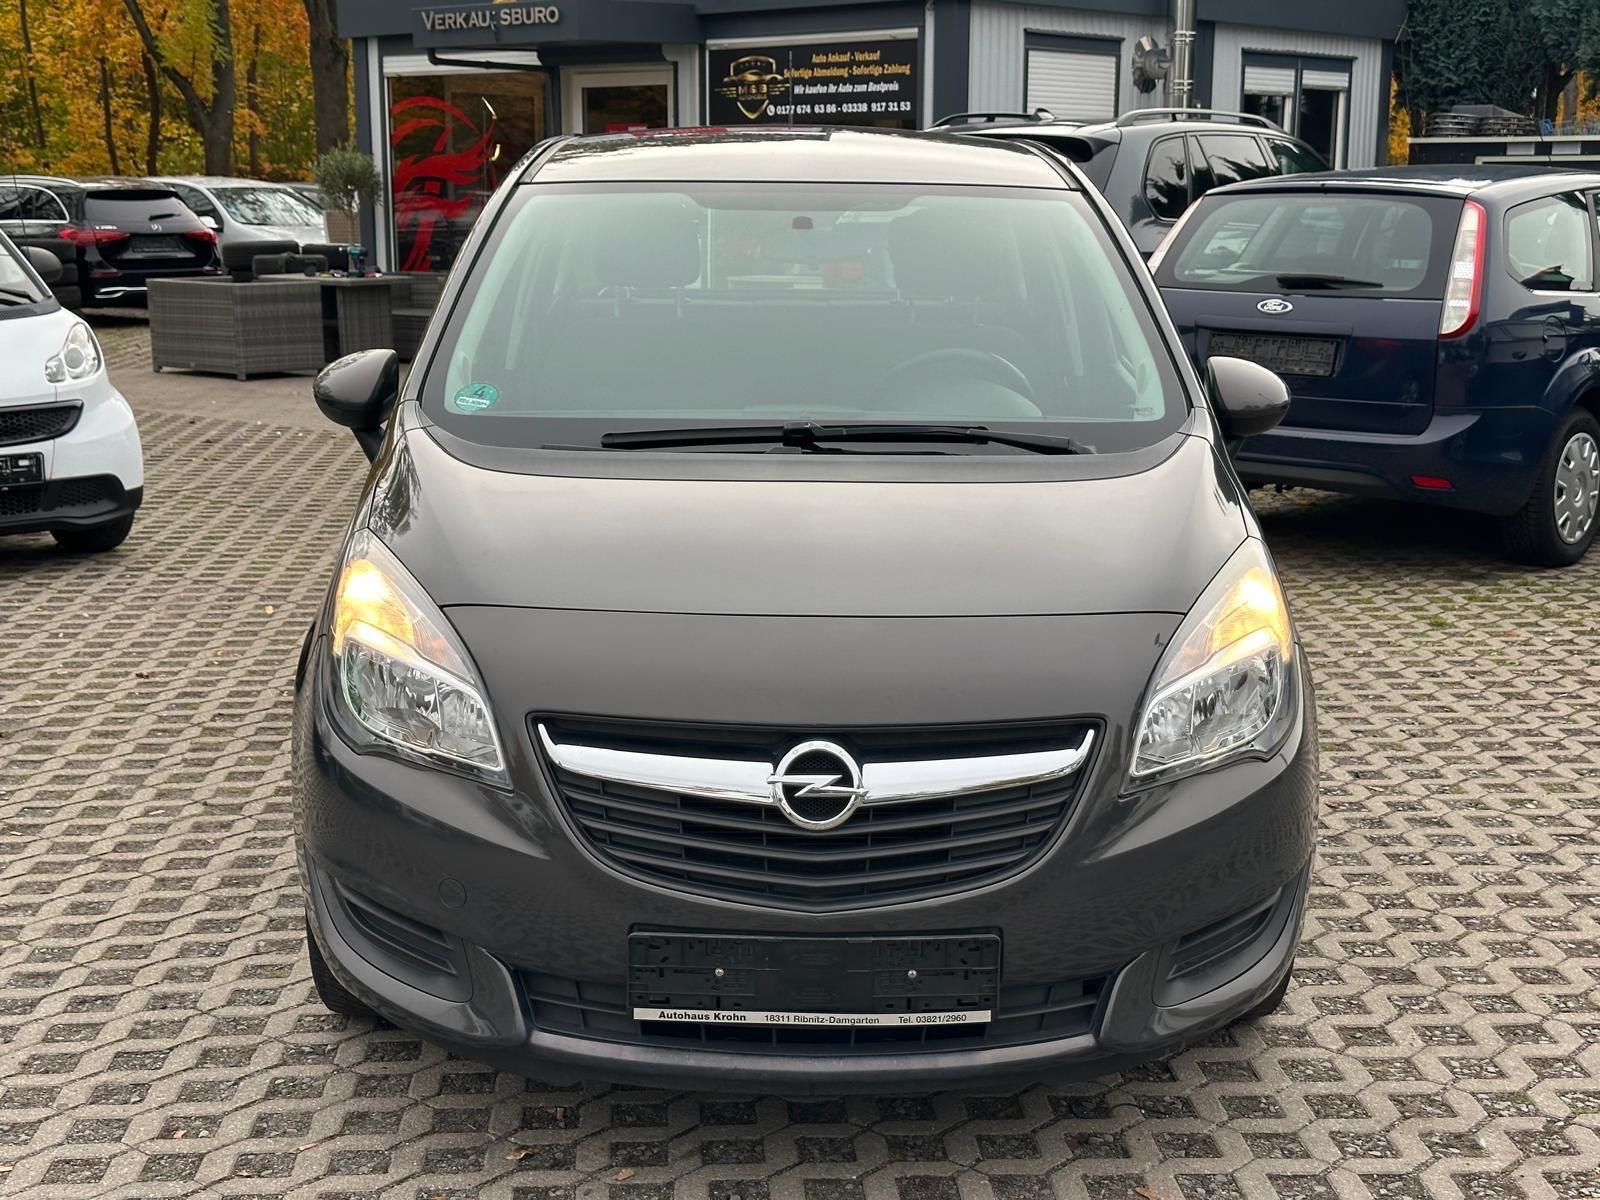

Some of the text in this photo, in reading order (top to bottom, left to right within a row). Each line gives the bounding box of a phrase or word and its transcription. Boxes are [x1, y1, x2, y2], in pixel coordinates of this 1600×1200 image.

[421, 6, 559, 30] VERKAUSBURO
[811, 50, 880, 63] Auto Ankauf Verkauf
[783, 68, 813, 79] Sofortige
[852, 64, 882, 76] Sofortige
[883, 63, 911, 75] Zahlung
[793, 84, 805, 95] Wir
[805, 83, 828, 94] kaufen
[837, 82, 854, 93] Auto
[853, 84, 868, 93] zum
[867, 80, 899, 93] Bestpreis
[776, 104, 796, 115] 0177
[796, 104, 811, 114] 674
[814, 103, 825, 113] 63
[841, 102, 868, 113] 03338
[871, 102, 887, 112] 917
[887, 101, 899, 112] 31
[900, 101, 911, 111] 53
[1260, 300, 1288, 313] Ford
[658, 1010, 967, 1026] Autohaus Krohn 18311 Ribnitz-Damgarten Tel. 03821/2960
